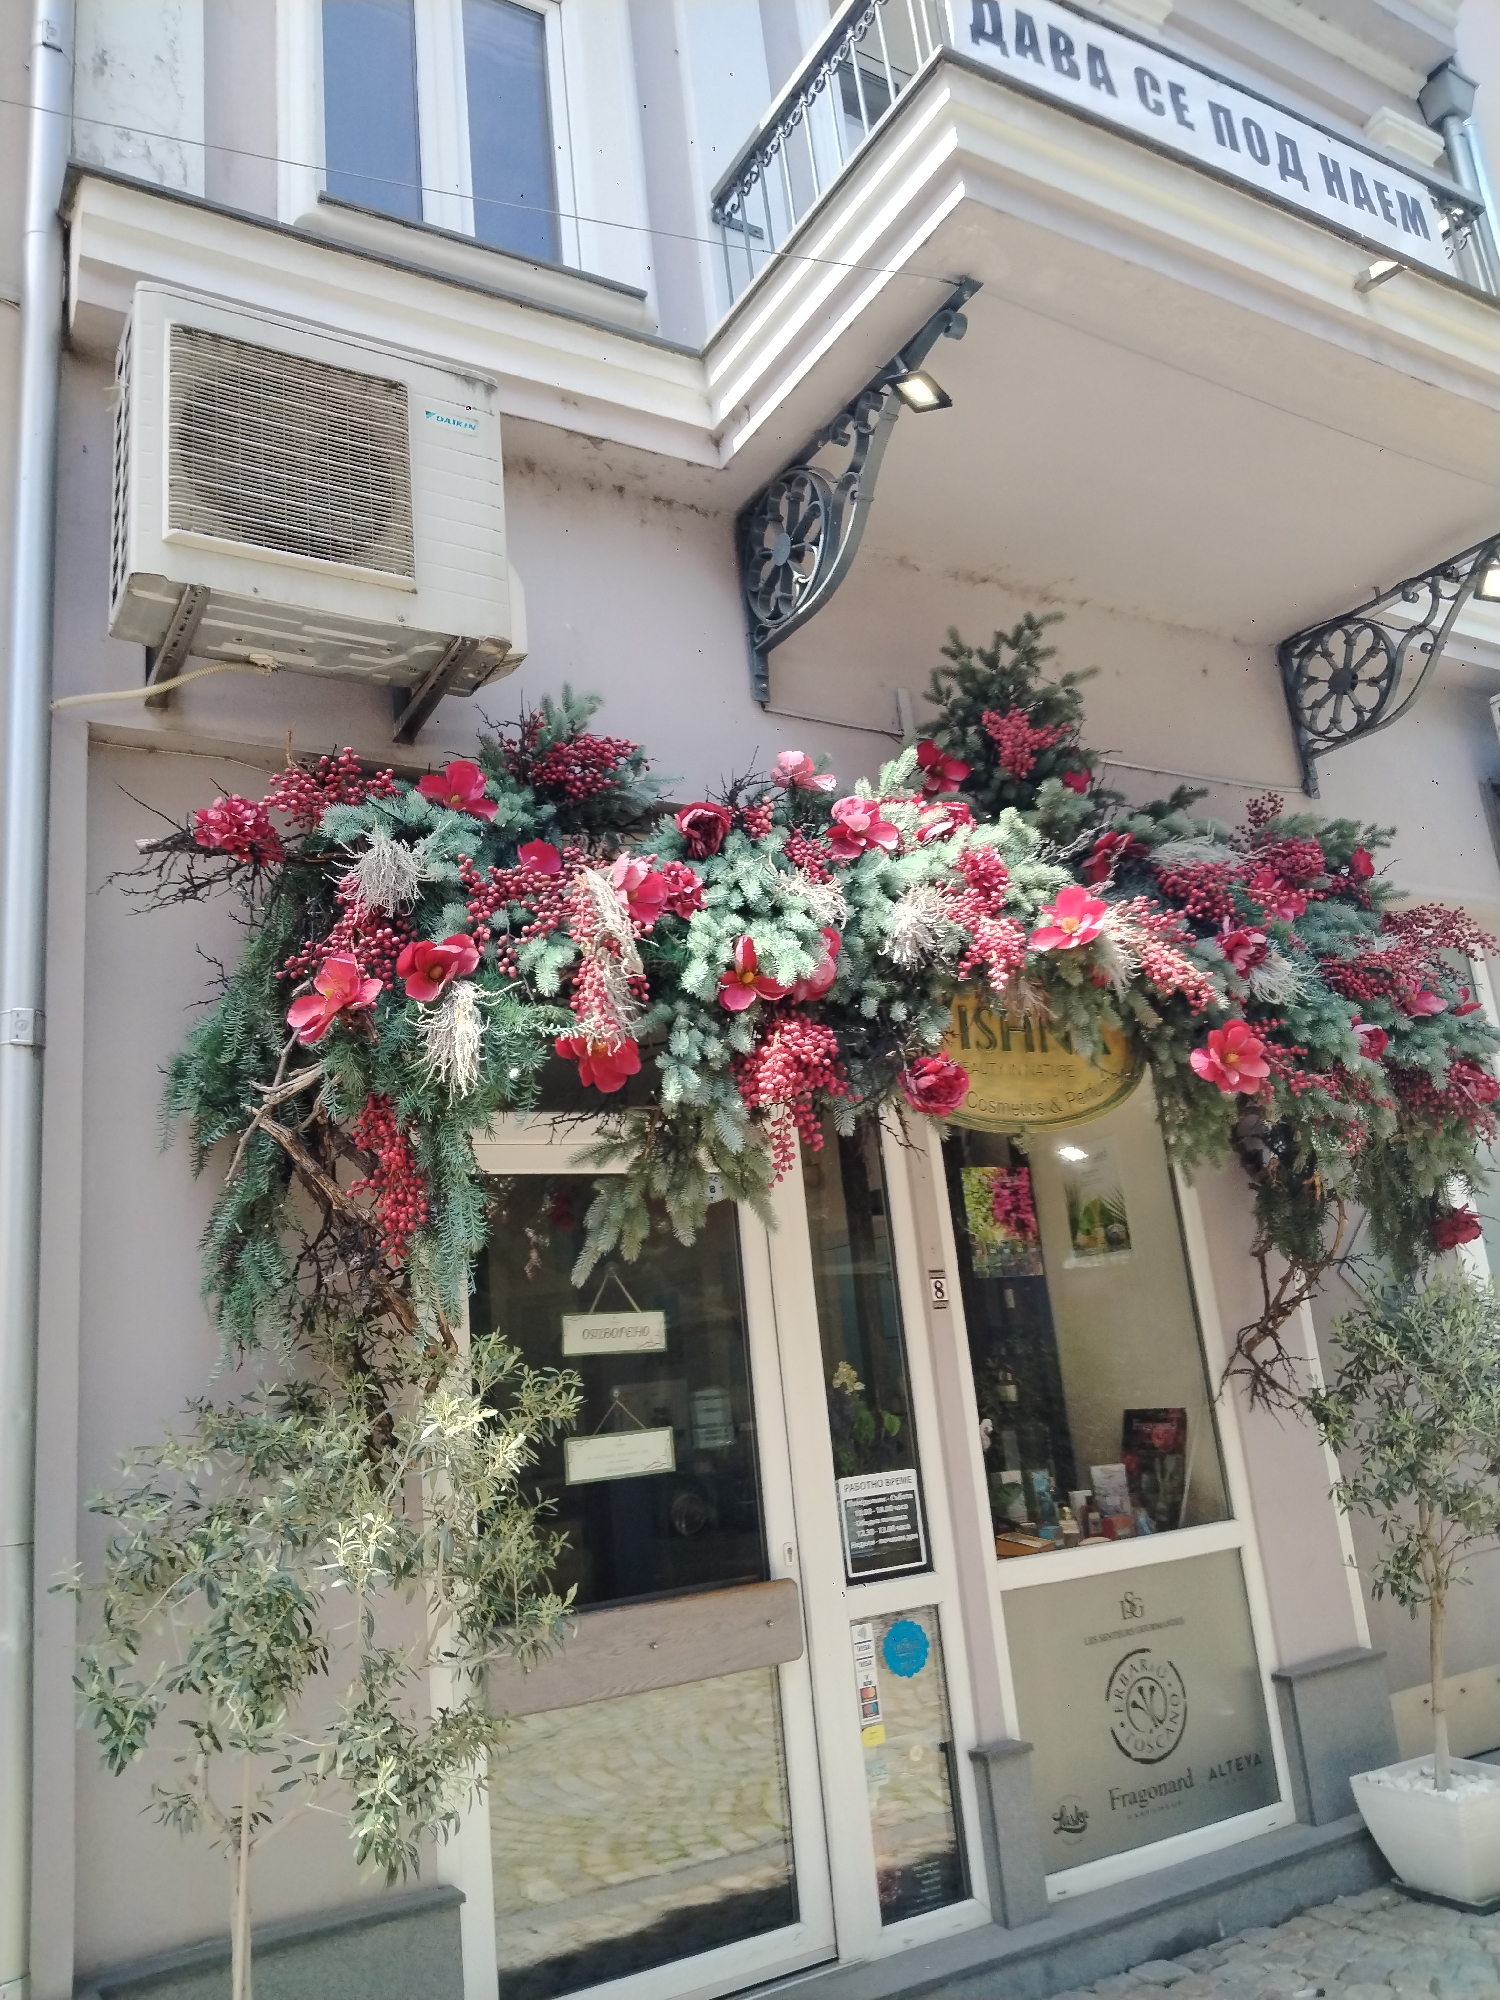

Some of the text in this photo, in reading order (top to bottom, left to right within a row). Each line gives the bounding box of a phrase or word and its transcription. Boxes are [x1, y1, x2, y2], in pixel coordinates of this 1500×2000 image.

[969, 0, 1431, 242] ДАВА СЕ ПОД НАЕМ
[436, 415, 476, 430] DAIKIN
[966, 1090, 1044, 1117] Cosmetics
[1050, 1096, 1064, 1114] &
[934, 1280, 945, 1299] 8
[844, 1475, 913, 1493] РАБОТНО ВРЕМЕ
[1209, 1753, 1263, 1781] ALTEYA
[1108, 1767, 1195, 1811] Fragonard
